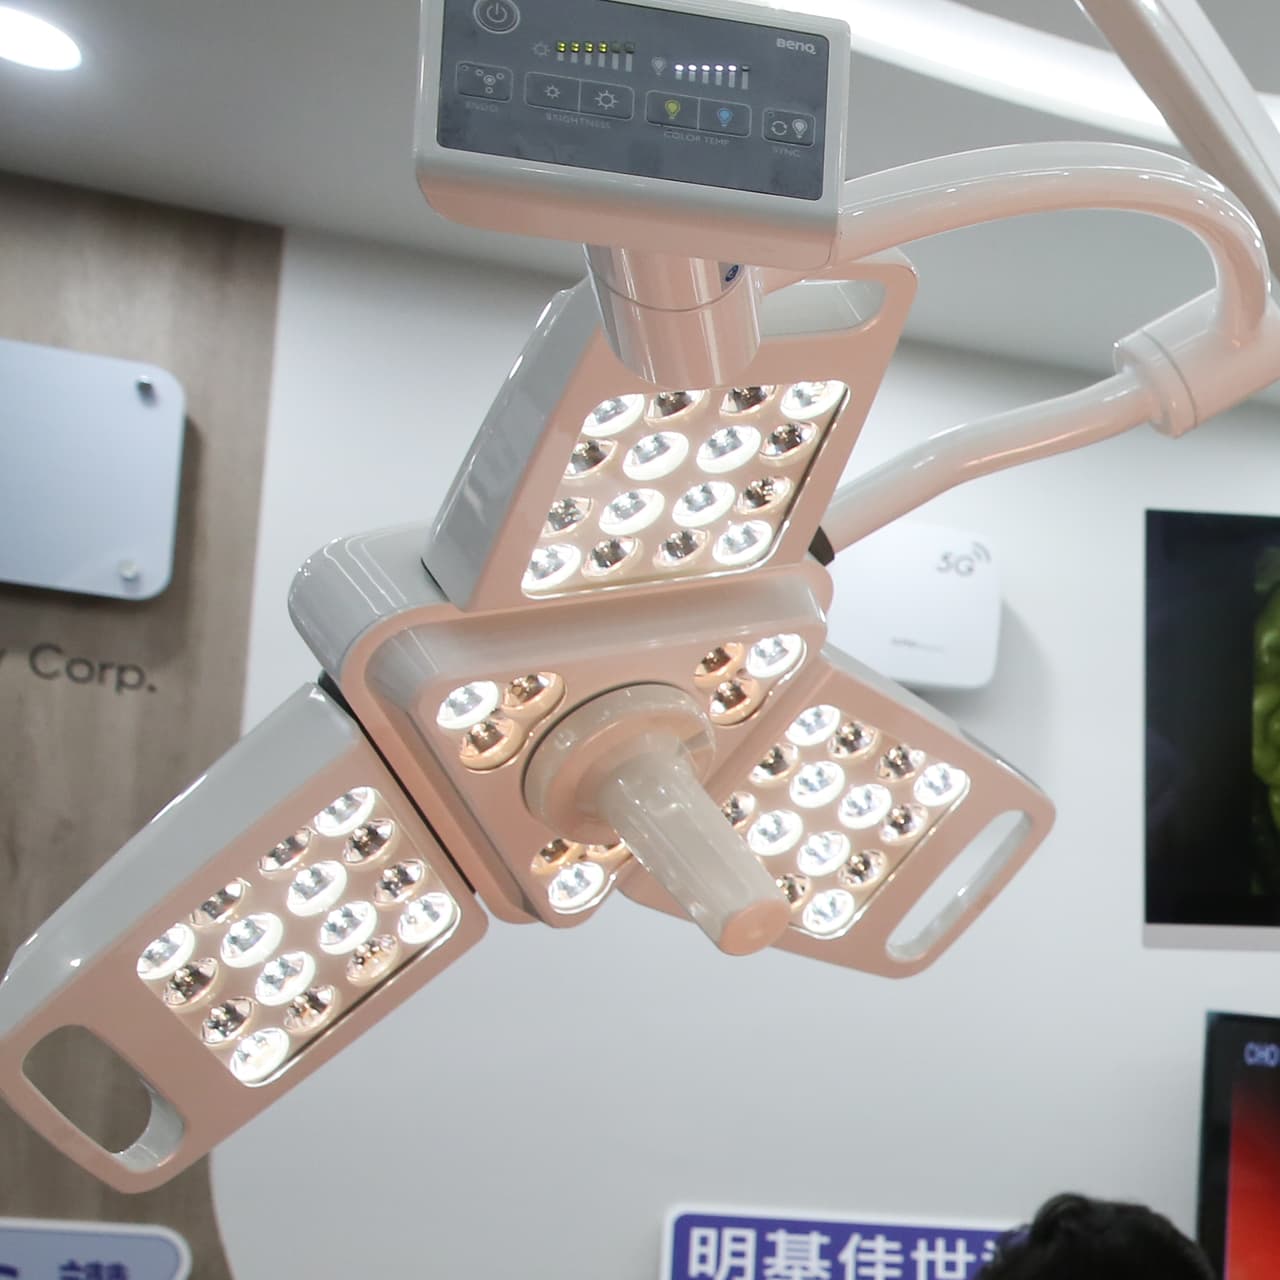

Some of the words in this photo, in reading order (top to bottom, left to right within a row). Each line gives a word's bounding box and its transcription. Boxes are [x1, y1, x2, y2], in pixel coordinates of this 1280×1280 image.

[776, 38, 817, 55] BenQ
[663, 129, 700, 142] COLOR
[936, 551, 974, 577] 5G
[29, 643, 157, 695] Corp.
